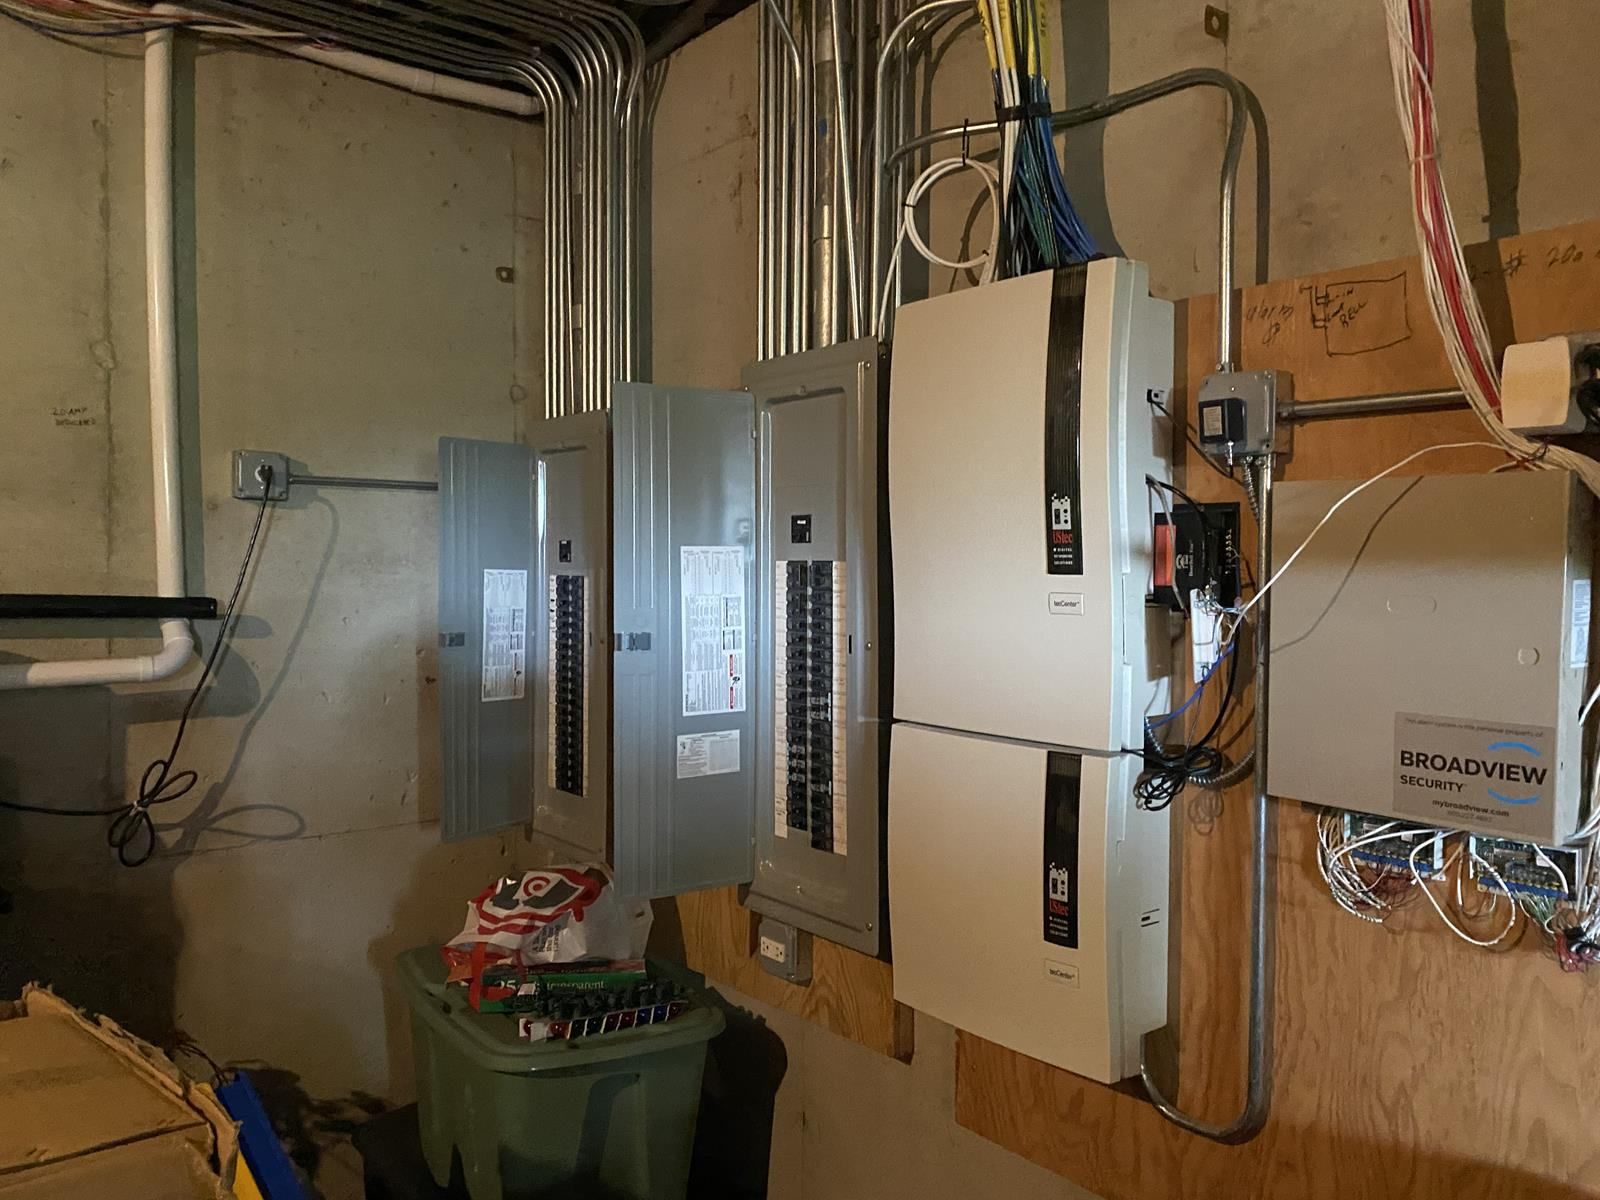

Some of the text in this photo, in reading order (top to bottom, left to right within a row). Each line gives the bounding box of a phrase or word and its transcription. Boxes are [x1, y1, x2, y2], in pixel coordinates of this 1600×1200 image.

[1400, 750, 1548, 786] BROADVIEW
[1400, 774, 1464, 793] SECURITY
[1432, 799, 1510, 817] mybroadview.com
